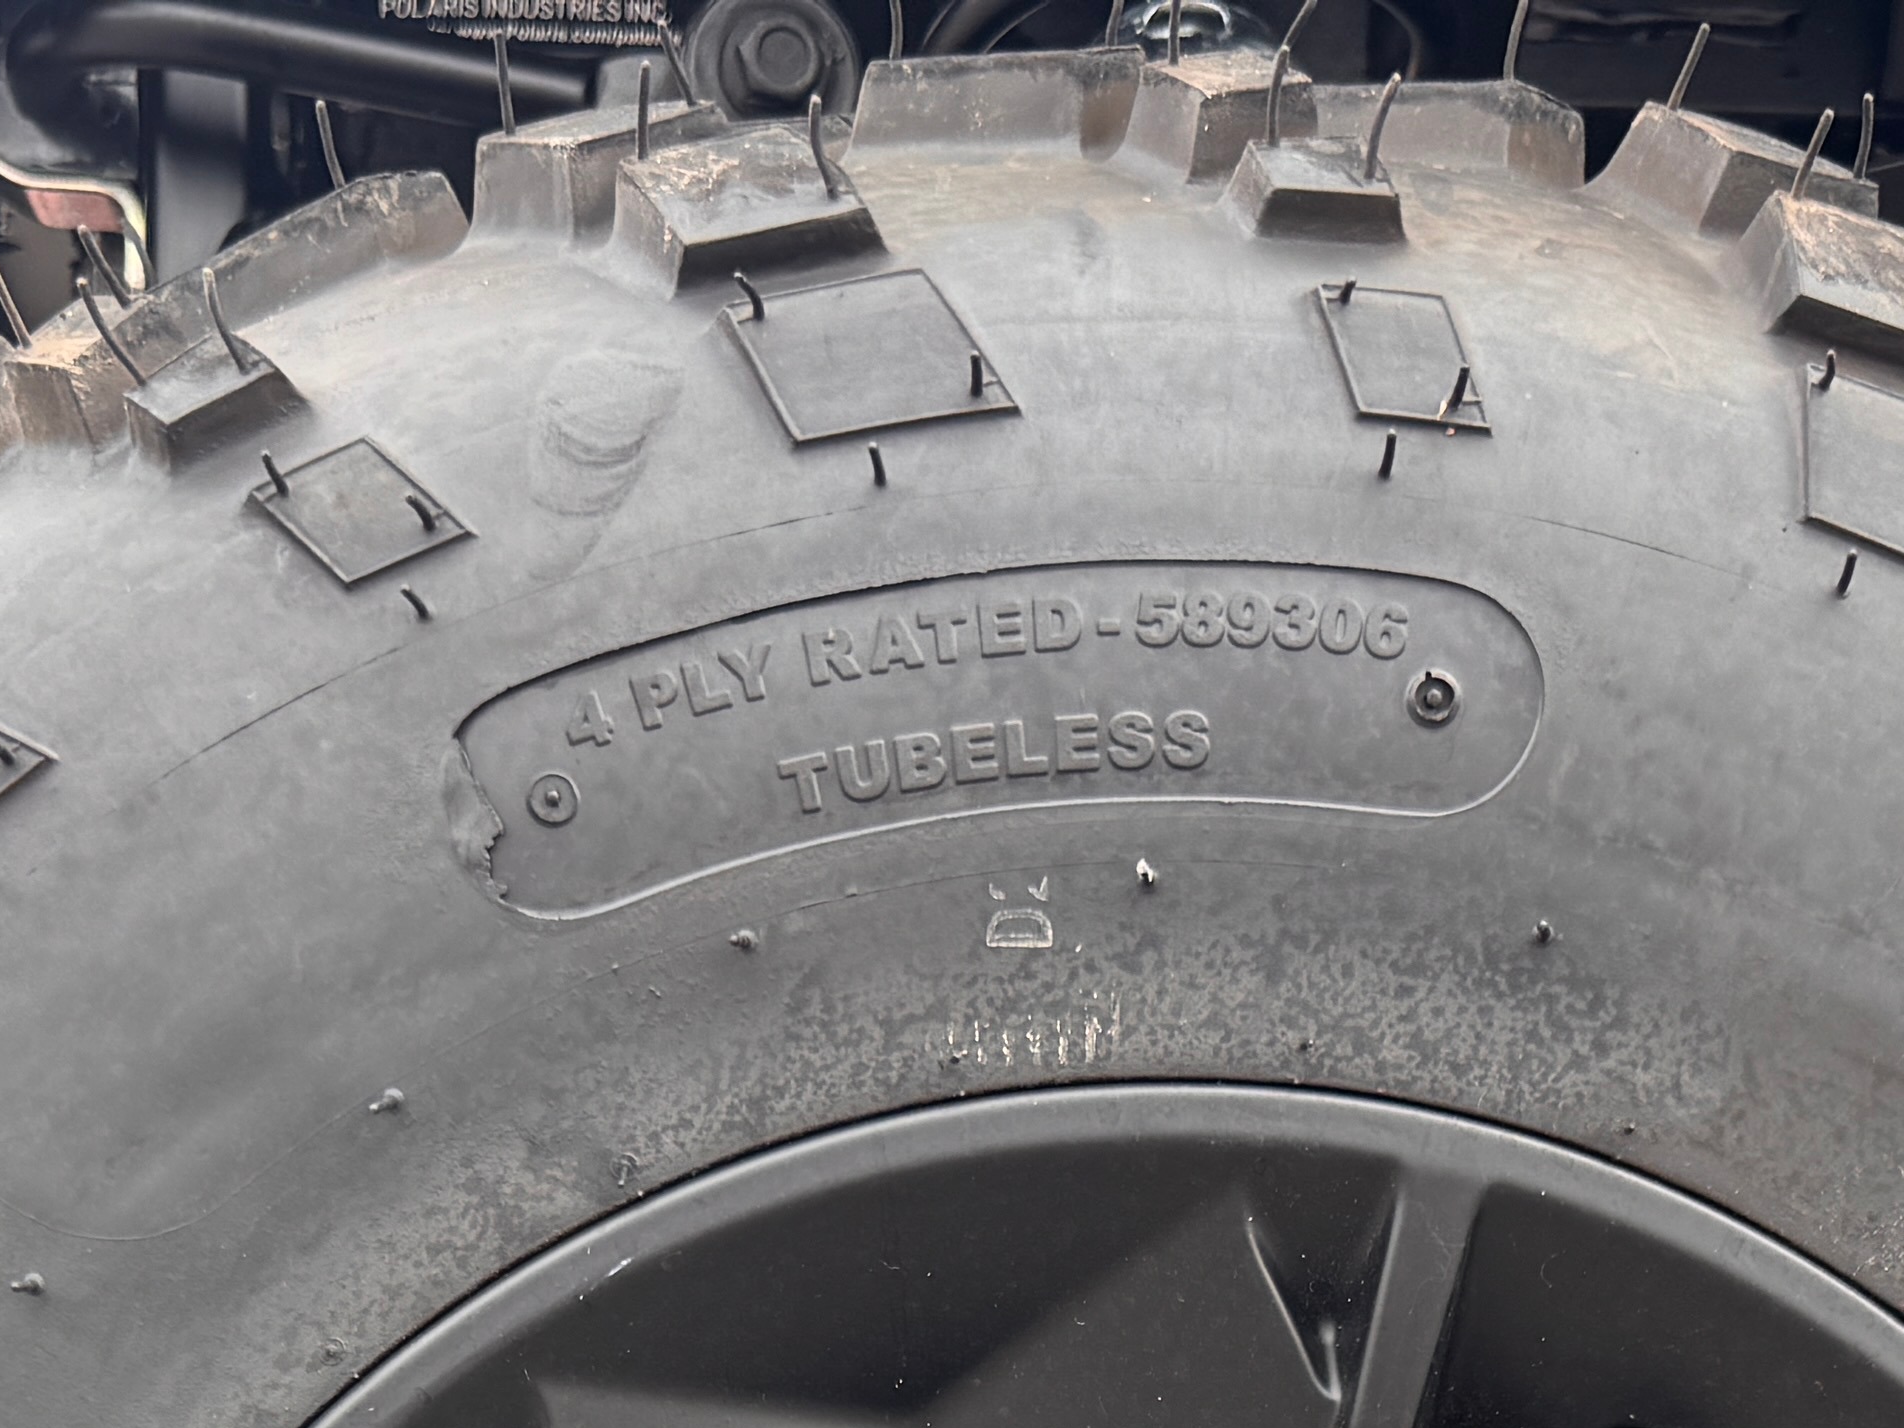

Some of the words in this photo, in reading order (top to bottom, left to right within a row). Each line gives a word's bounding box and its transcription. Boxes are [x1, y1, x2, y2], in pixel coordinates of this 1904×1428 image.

[566, 690, 615, 748] 4
[629, 640, 772, 731] PLY
[777, 709, 1211, 814] TUBELESS
